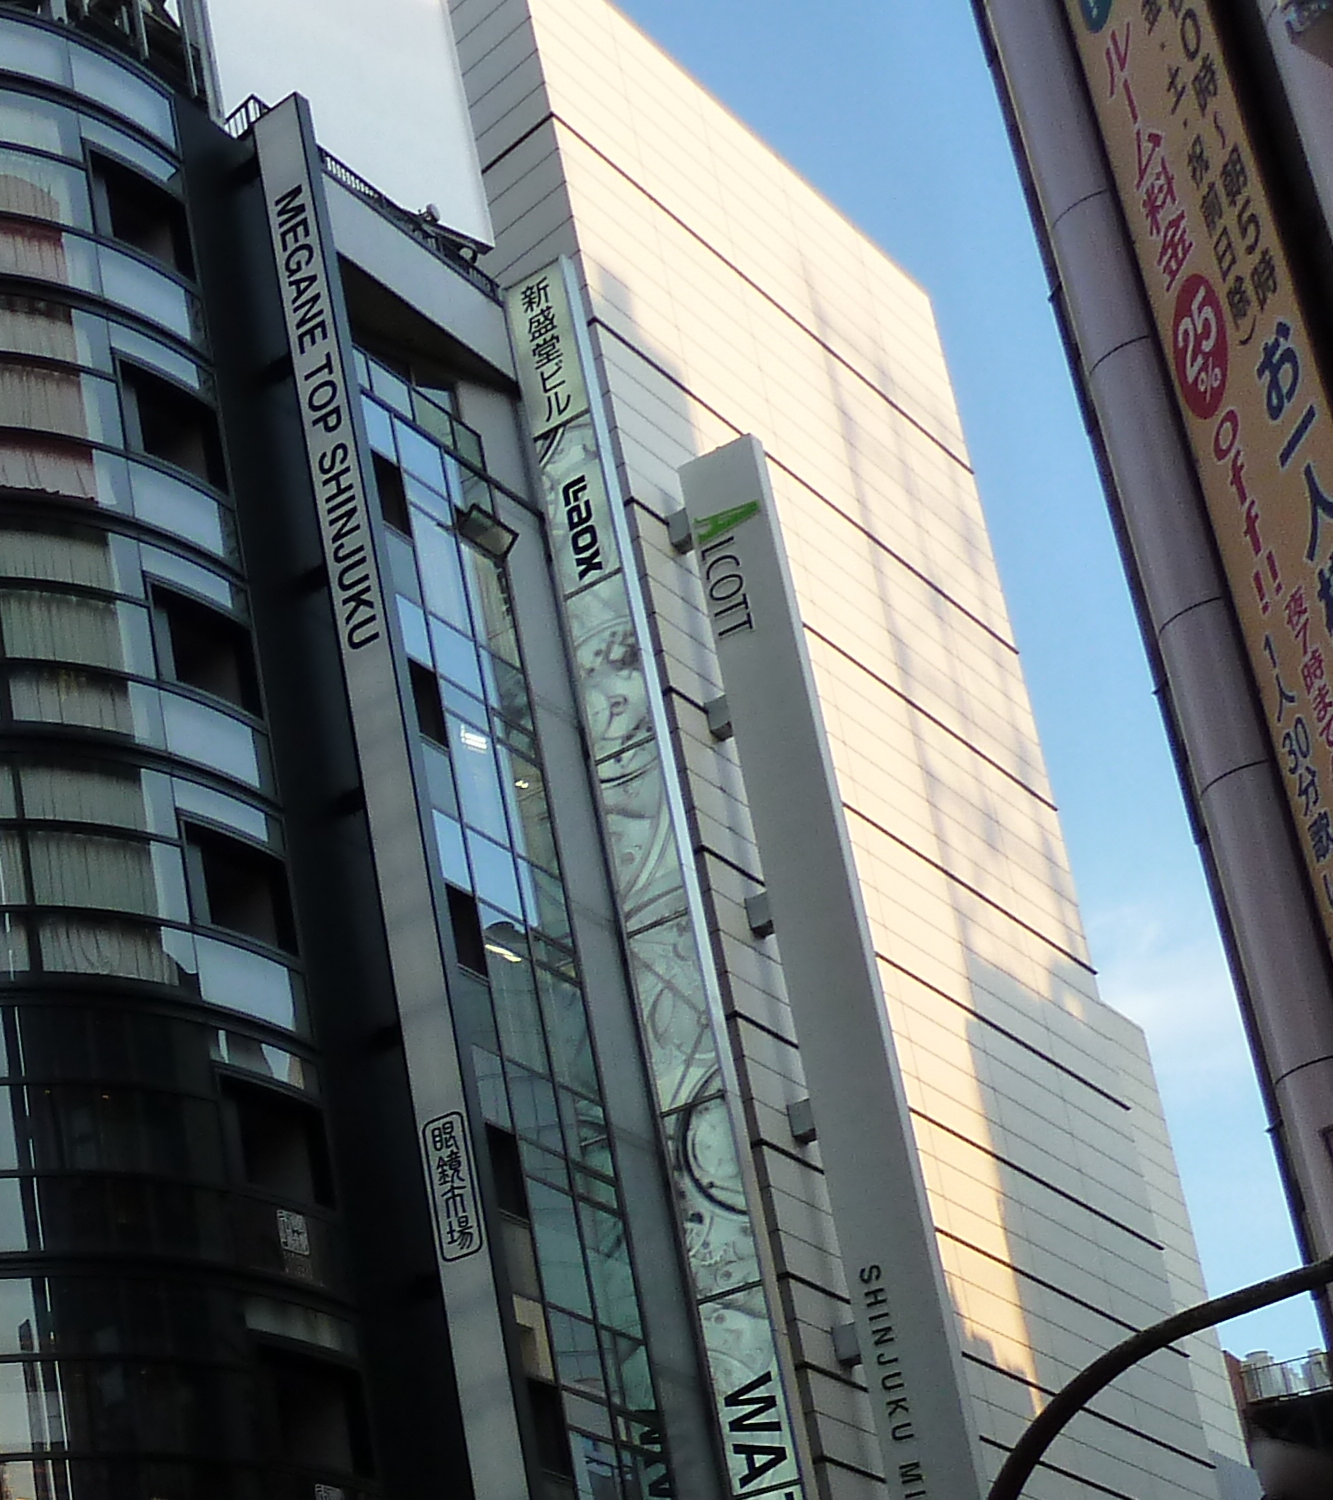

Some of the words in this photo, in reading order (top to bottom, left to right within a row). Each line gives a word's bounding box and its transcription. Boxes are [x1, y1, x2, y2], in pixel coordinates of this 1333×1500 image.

[274, 185, 329, 355] MEGANE
[301, 354, 344, 435] TOP
[520, 276, 573, 424] 新盛堂ビル
[317, 445, 380, 652] SHINJUKU
[693, 499, 762, 639] ALCOTT
[431, 1120, 475, 1251] 眼鏡市場
[858, 1263, 917, 1443] SHINJUKU
